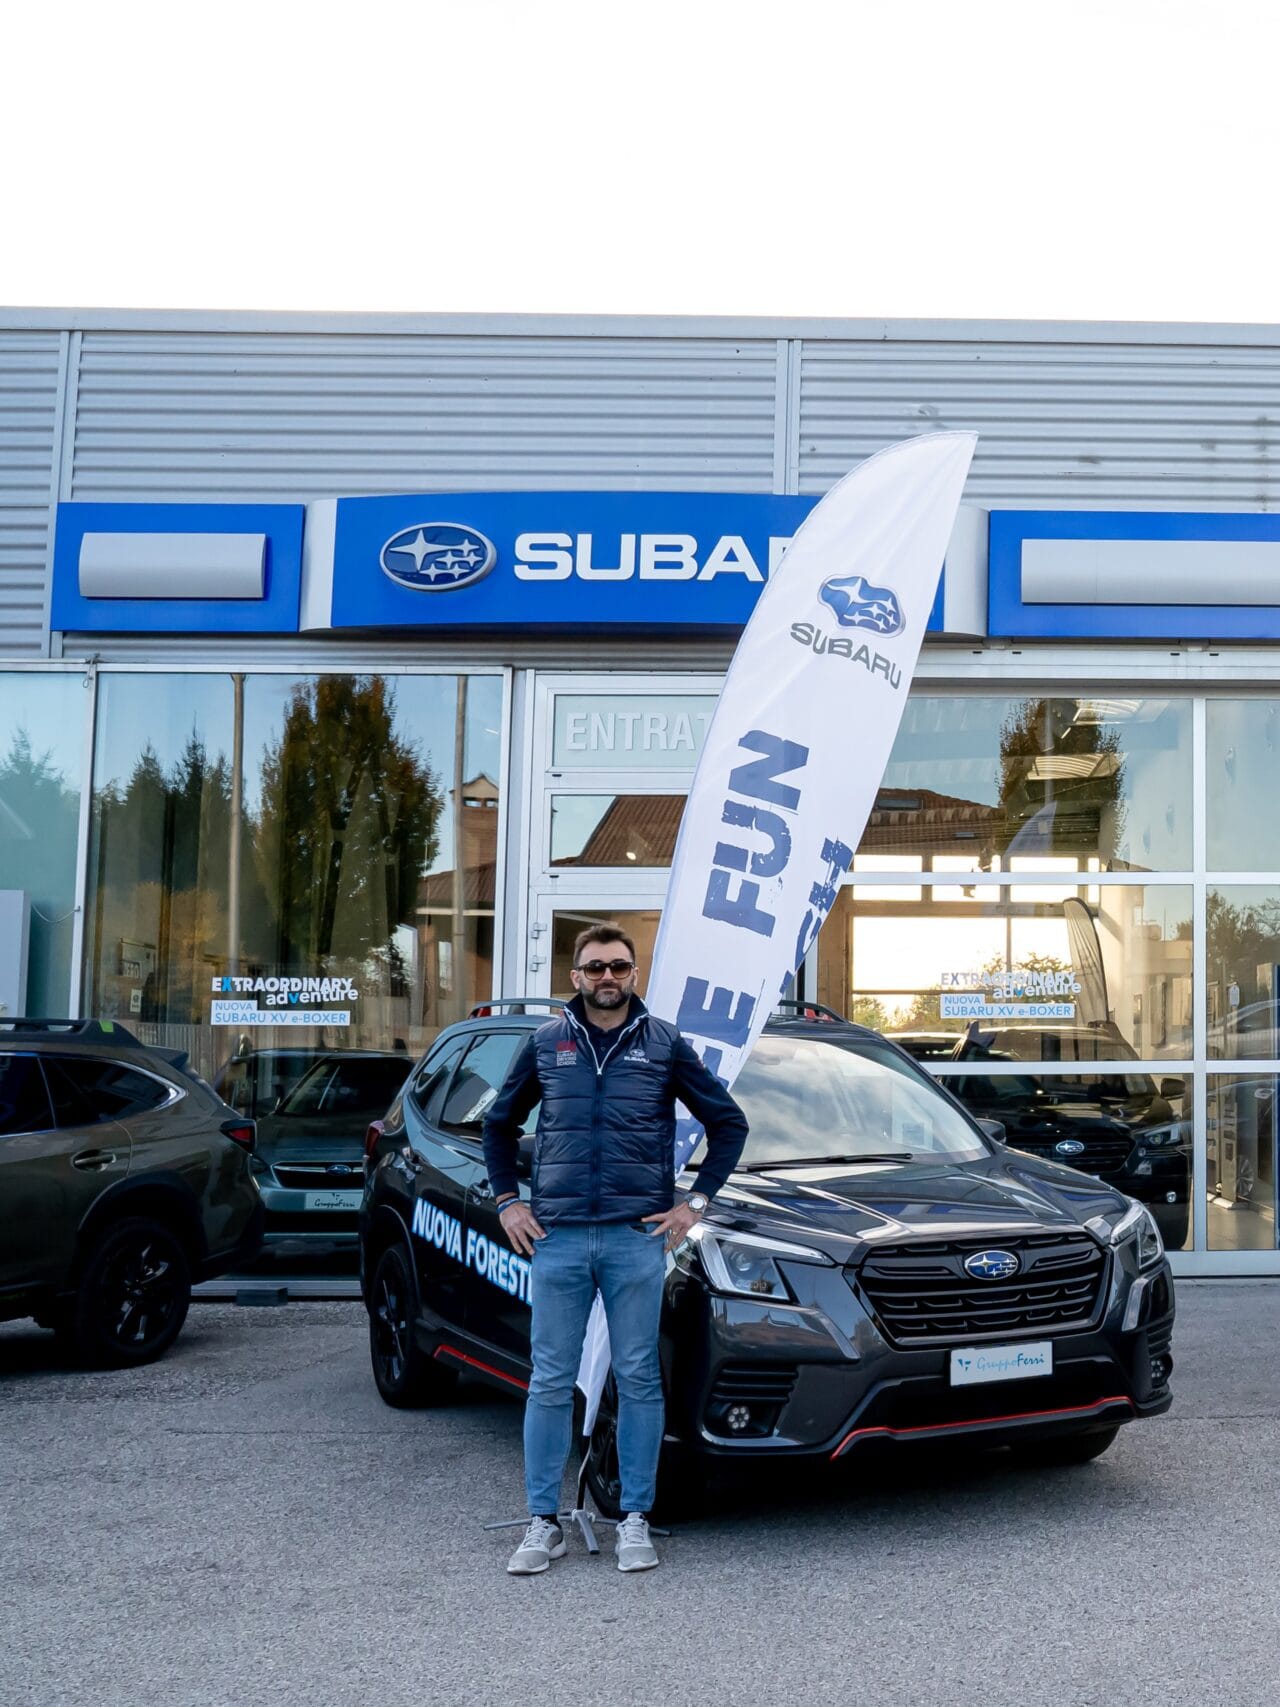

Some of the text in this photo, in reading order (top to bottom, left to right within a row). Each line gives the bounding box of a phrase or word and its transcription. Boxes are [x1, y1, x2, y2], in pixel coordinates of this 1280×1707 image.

[790, 622, 902, 691] SUBARU
[566, 711, 707, 752] ENTRA
[702, 729, 810, 939] FUN
[211, 976, 354, 993] EXTRAORDINARY
[941, 971, 1077, 986] EXTRAORDINARY
[265, 988, 359, 1006] adventure
[992, 981, 1082, 999] adventure
[215, 1002, 253, 1011] NUOVA
[944, 995, 981, 1005] NUOVA
[215, 1012, 347, 1023] SUBARU XV e-BOXER
[944, 1006, 1071, 1016] SUBARU XV e-BOXER
[623, 1055, 650, 1063] SUBARU
[411, 1196, 463, 1263] NUOVA
